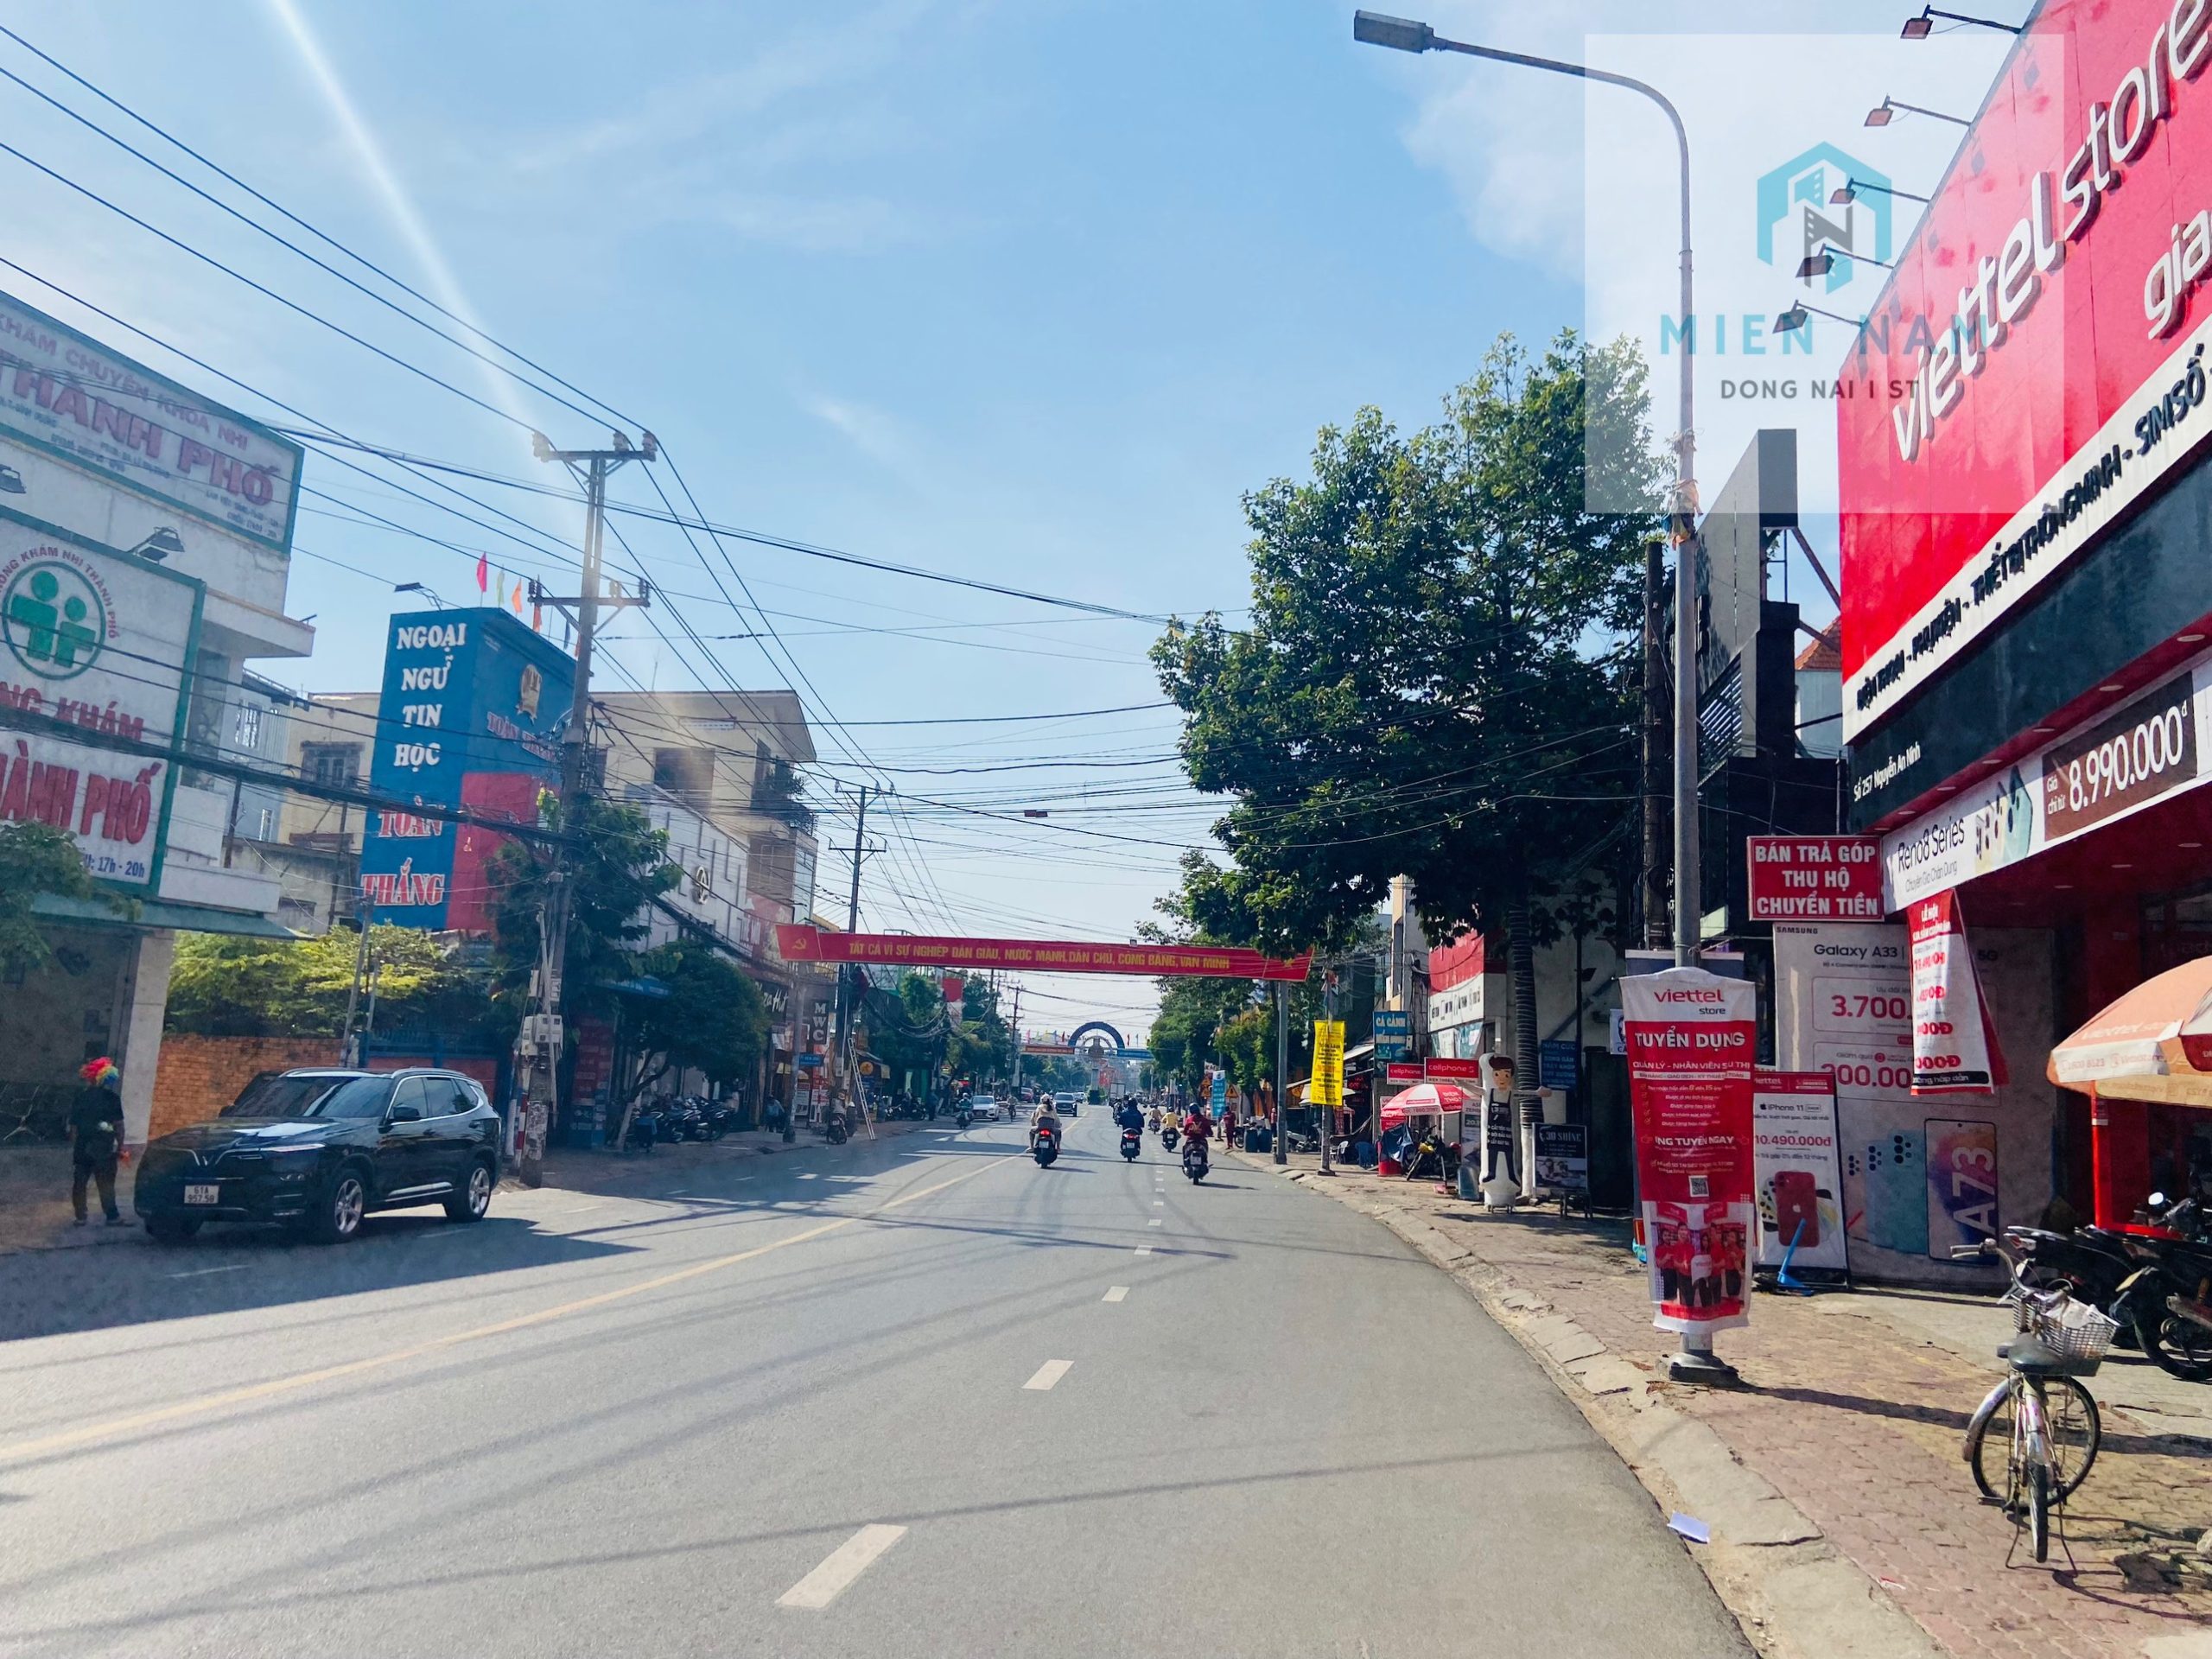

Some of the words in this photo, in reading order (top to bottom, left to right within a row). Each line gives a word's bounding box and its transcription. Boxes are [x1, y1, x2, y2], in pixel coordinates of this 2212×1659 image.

[1892, 171, 2067, 461] viettel
[66, 348, 149, 401] CHUYÊN
[156, 393, 210, 433] KHOA
[218, 423, 249, 452] NHI
[177, 436, 282, 506] PHỐ
[21, 544, 59, 562] KHÁM
[61, 550, 85, 567] NHI
[85, 563, 114, 608] THÀNH
[107, 610, 121, 639] PHỐ
[396, 622, 467, 652] NGOẠI
[401, 654, 454, 690] NGỮ
[402, 703, 443, 728] TIN
[393, 742, 442, 773] HỌC
[1897, 753, 1906, 773] An
[1906, 741, 1921, 767] Ninh
[2047, 774, 2058, 793] Giá
[79, 762, 162, 845] PHỐ
[1755, 841, 1791, 863] BÁN
[1796, 840, 1833, 863] TRẢ
[1838, 841, 1876, 863] GÓP
[1897, 828, 1929, 874] Reno8
[1931, 816, 1965, 857] Series
[97, 856, 116, 872] 17h
[124, 861, 145, 879] 20h
[359, 856, 446, 906] THẮNG
[1782, 870, 1819, 888] THU
[1824, 867, 1850, 892] HỘ
[1756, 890, 1830, 915] CHUYỂN
[1835, 891, 1878, 916] TIỀN
[1776, 926, 1819, 935] SAMSUNG
[849, 941, 865, 955] TẤT
[868, 941, 881, 956] CẢ
[883, 942, 893, 956] VÌ
[896, 944, 911, 958] SỰ
[912, 944, 949, 959] NGHIỆP
[951, 945, 973, 959] DÂN
[1004, 947, 1032, 961] NƯỚC
[1068, 950, 1090, 963] DÂN
[1118, 951, 1146, 965] CÔNG
[1203, 957, 1230, 969] MINH
[1814, 944, 1868, 961] Galaxy
[1872, 946, 1898, 958] A33
[1654, 988, 1725, 1003] viettel
[813, 1002, 827, 1041] MWC
[1699, 1007, 1726, 1015] store
[1634, 1026, 1690, 1049] TUYỂN
[1695, 1032, 1745, 1052] DỤNG
[1633, 1060, 1655, 1069] QUẢN
[1655, 1060, 1666, 1070] LÝ
[1672, 1060, 1699, 1070] NHÂN
[1700, 1061, 1721, 1070] VIÊN
[1708, 1136, 1734, 1145] NGAY
[1952, 1147, 1996, 1233] A73
